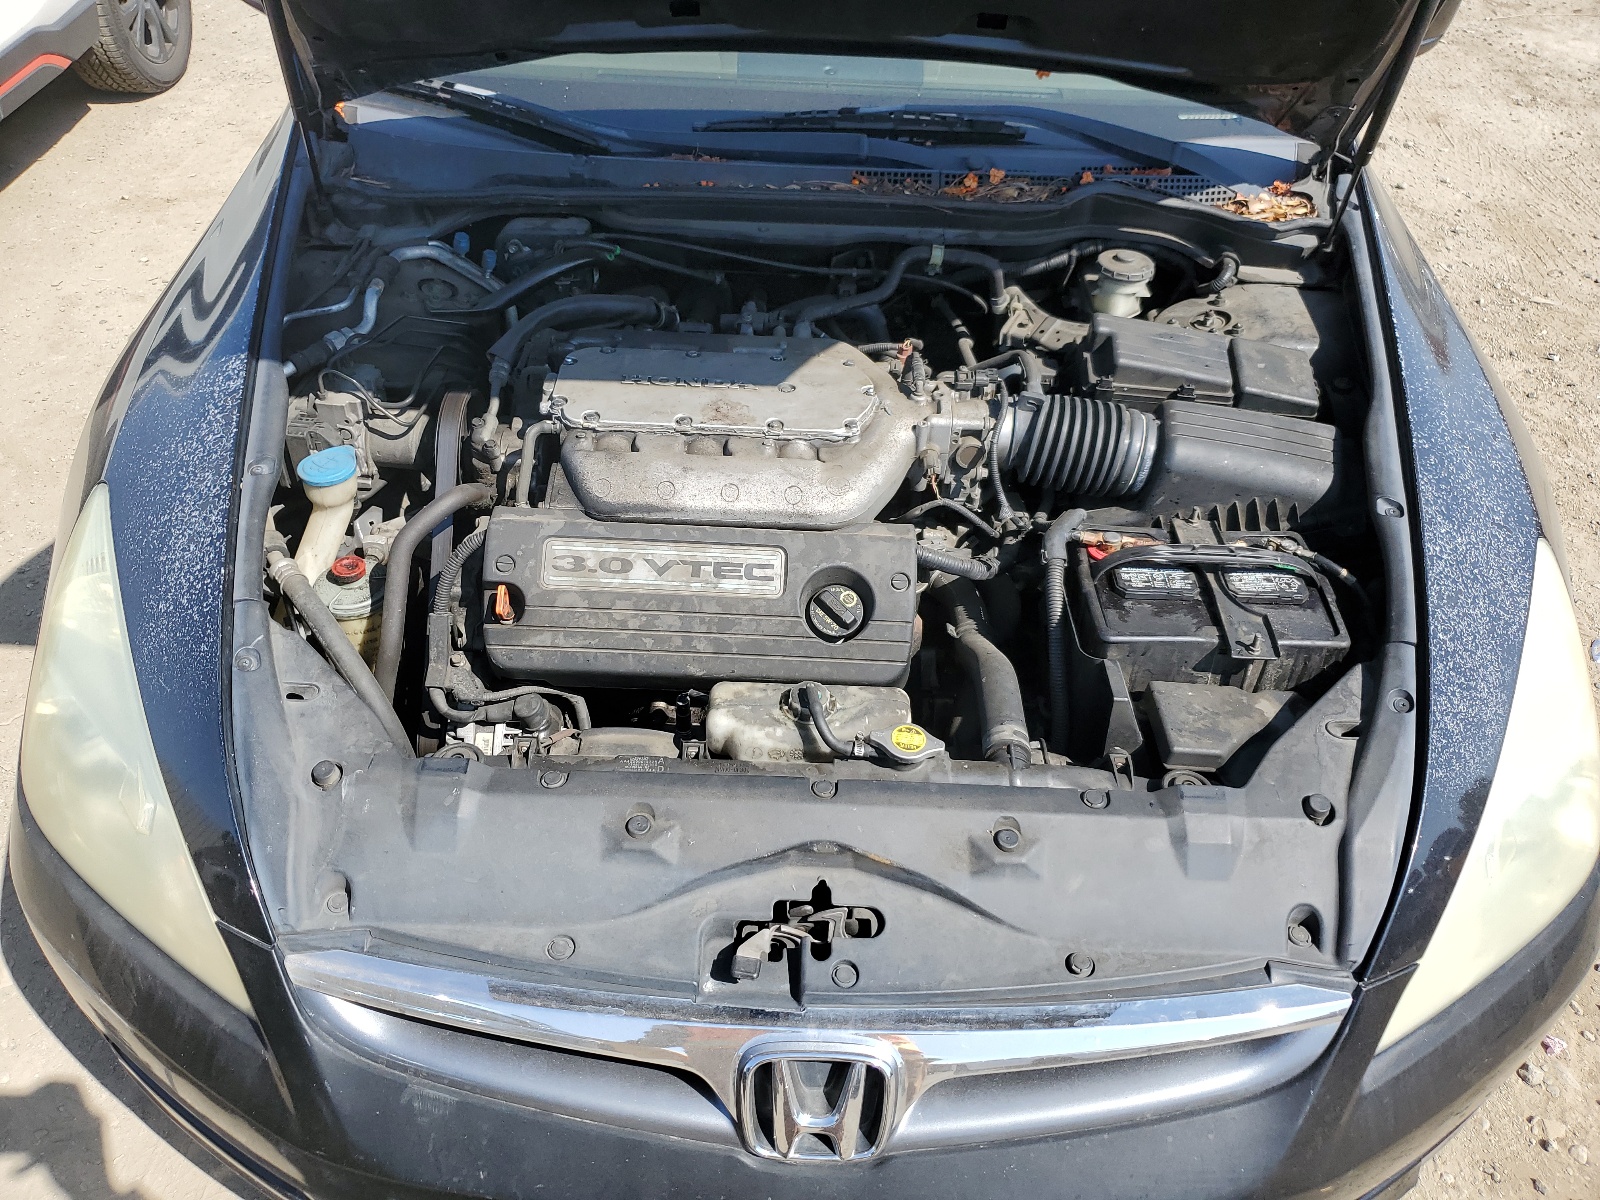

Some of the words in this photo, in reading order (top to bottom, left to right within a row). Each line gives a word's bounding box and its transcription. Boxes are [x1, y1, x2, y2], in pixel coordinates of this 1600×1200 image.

[621, 373, 759, 391] HONDA
[551, 554, 634, 575] 3.0
[643, 557, 775, 582] VTEC
